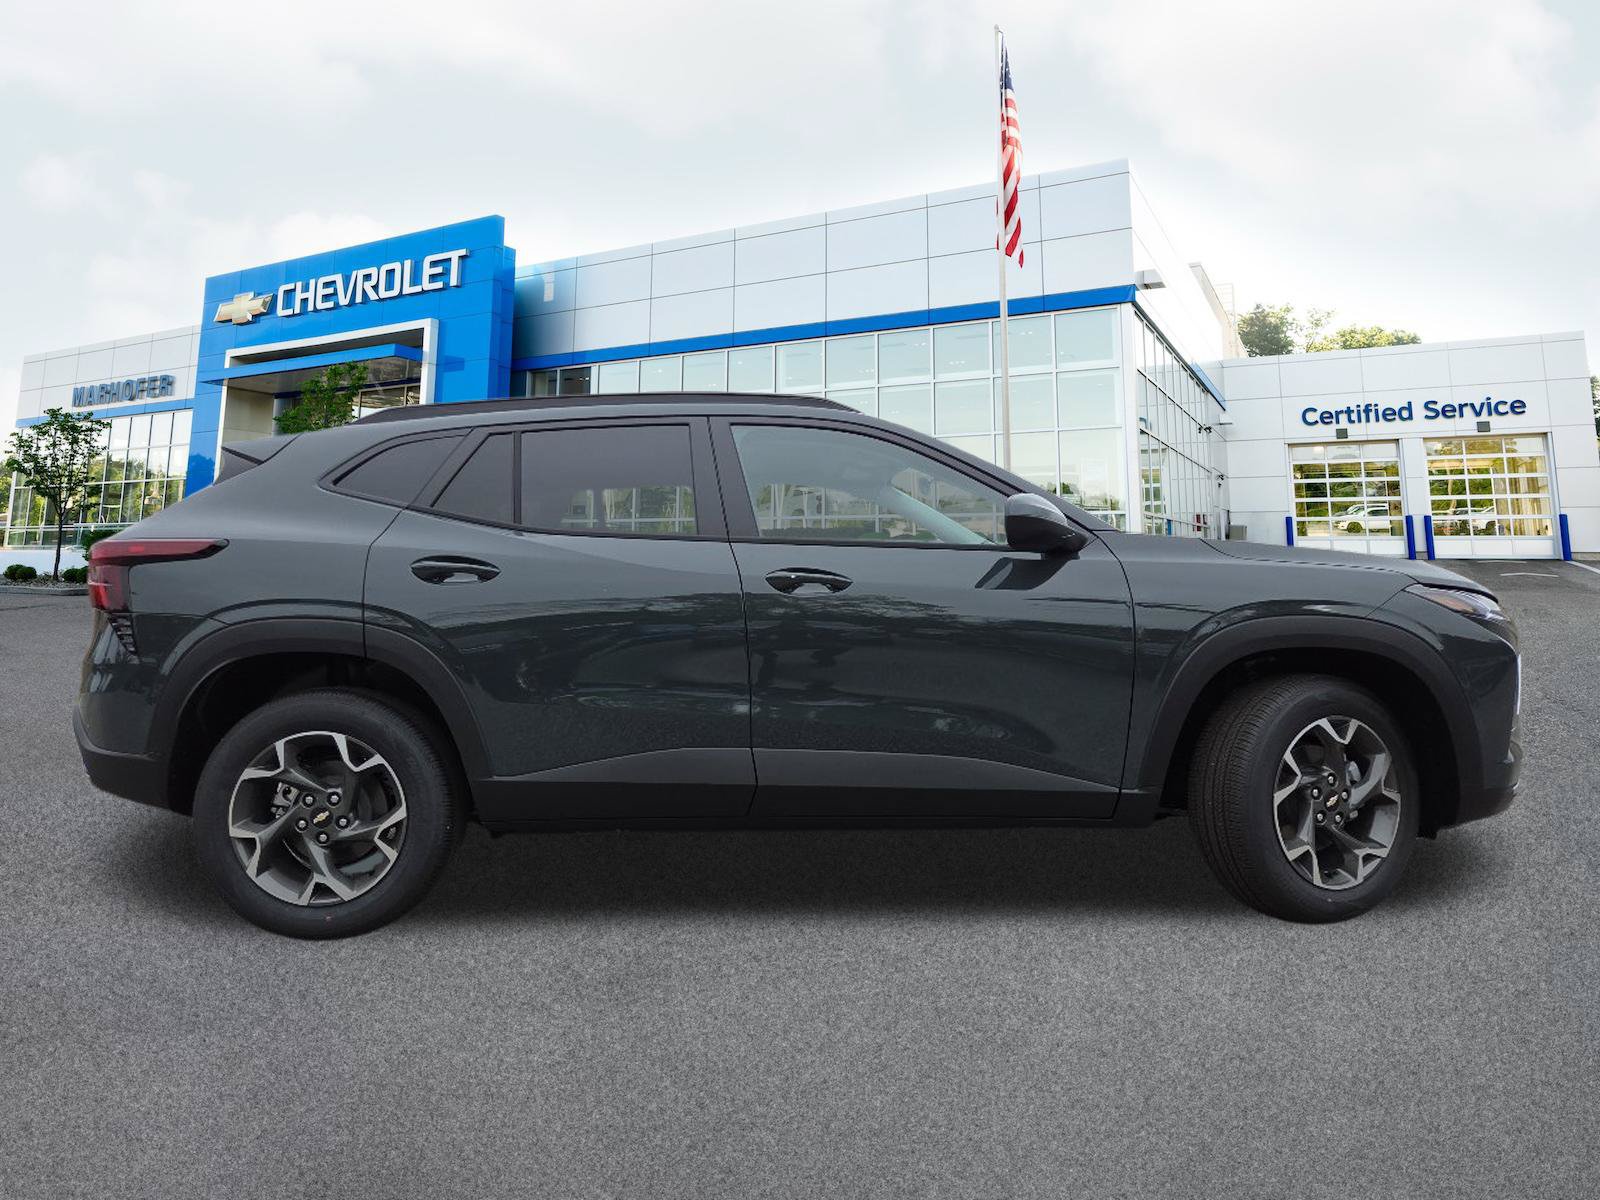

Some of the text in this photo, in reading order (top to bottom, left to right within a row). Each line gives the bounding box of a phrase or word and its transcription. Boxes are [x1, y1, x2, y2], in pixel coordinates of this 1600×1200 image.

[276, 247, 469, 317] CHEVROLET
[72, 374, 175, 408] MARHOFER
[1301, 396, 1527, 426] Certified Service
